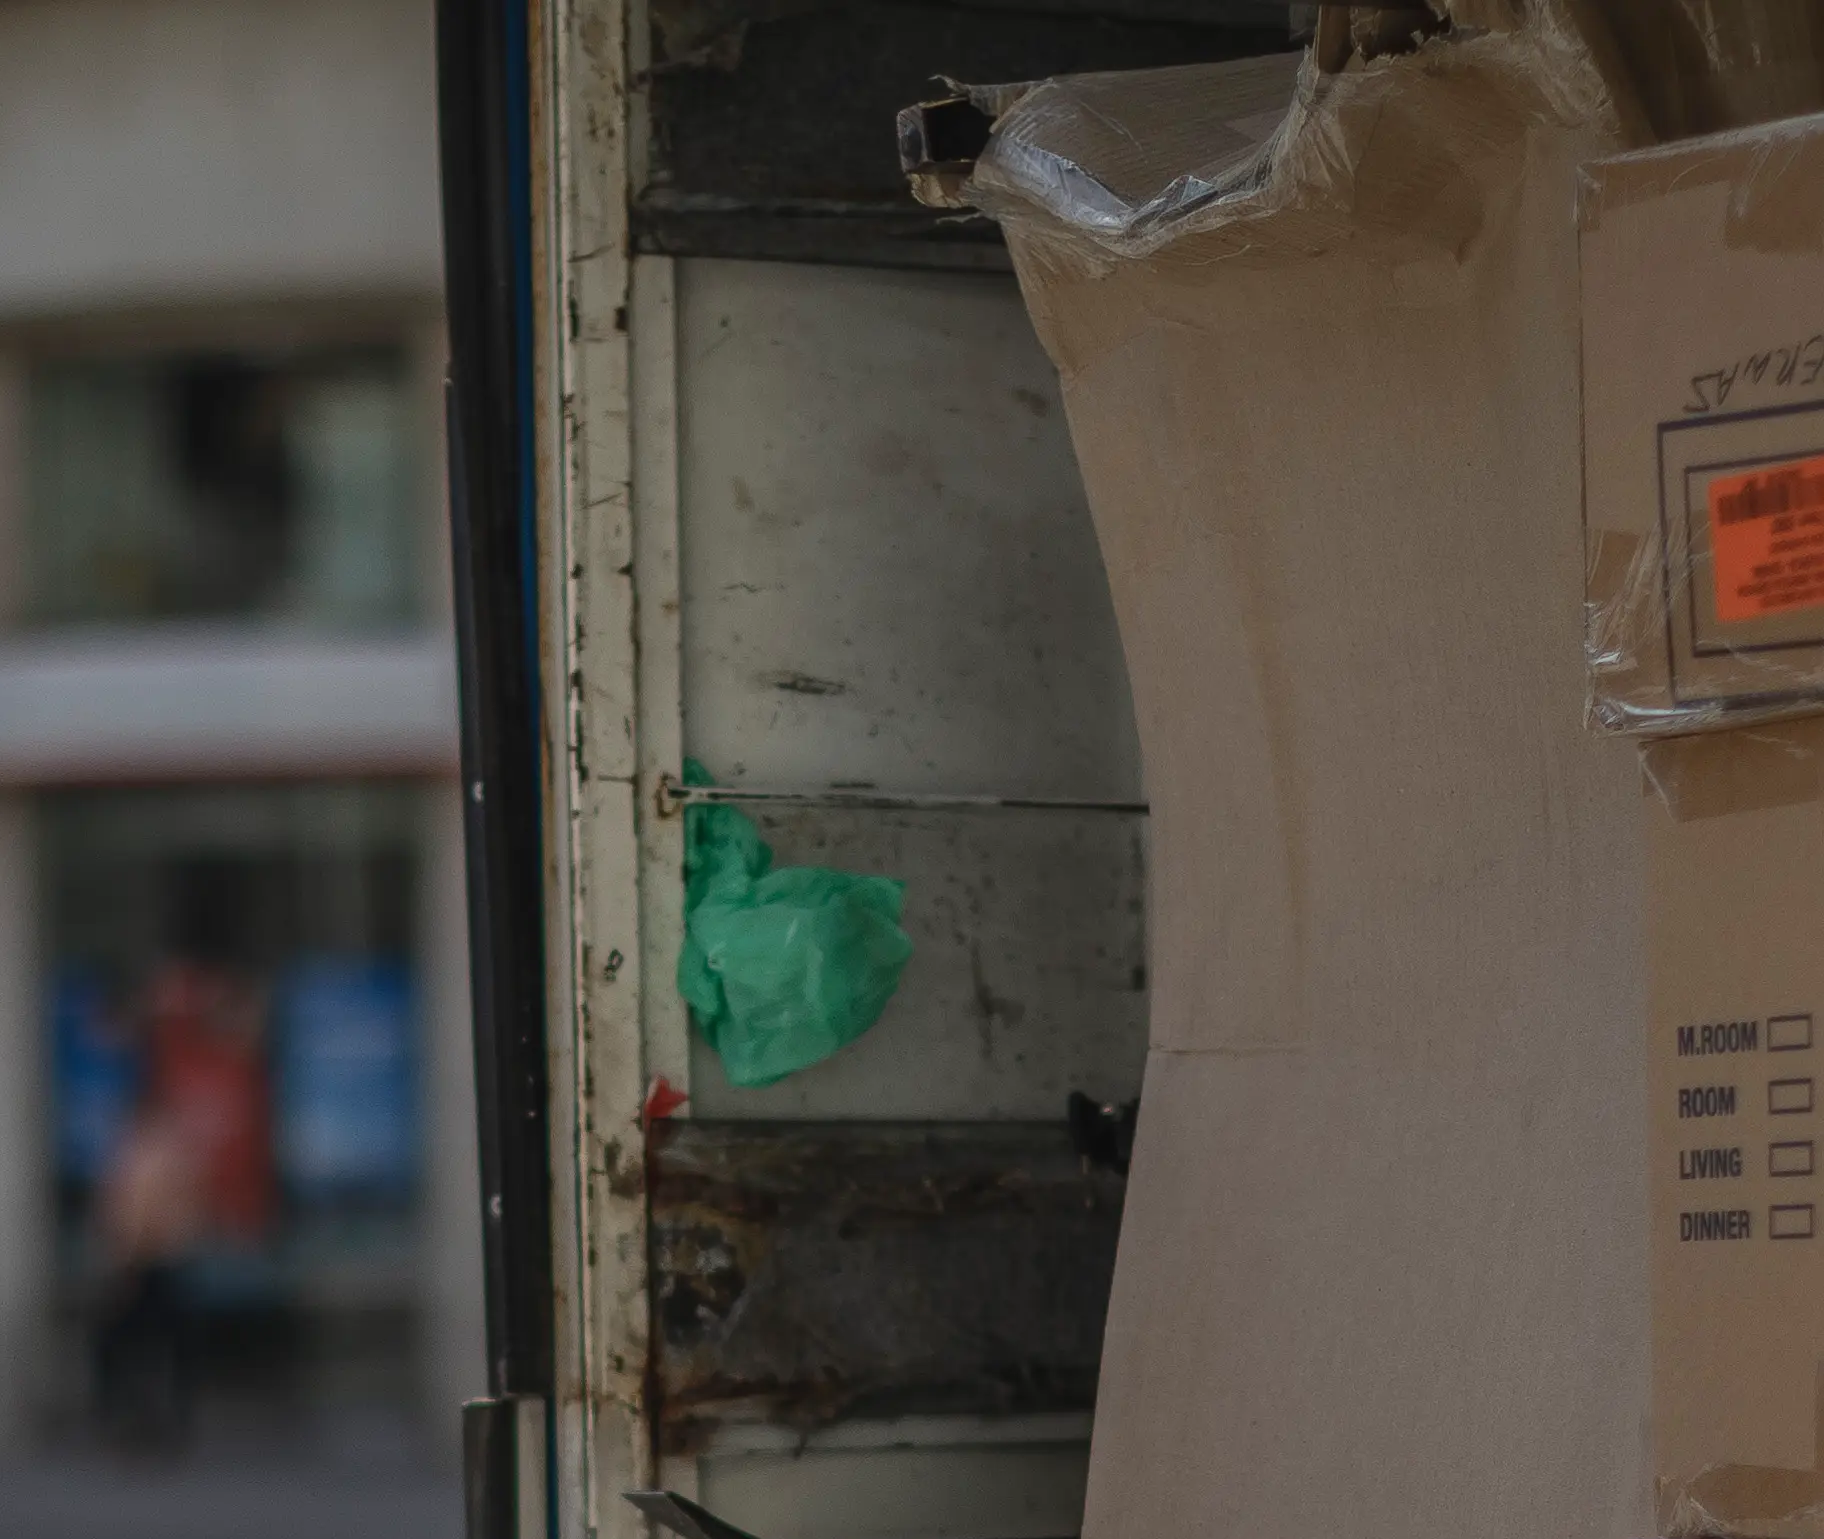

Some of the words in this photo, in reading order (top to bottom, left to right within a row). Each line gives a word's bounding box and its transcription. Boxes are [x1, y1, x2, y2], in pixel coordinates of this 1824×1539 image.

[1677, 1021, 1759, 1057] M.ROOM
[1678, 1086, 1737, 1119] ROOM
[1679, 1147, 1743, 1180] LIVING
[1680, 1209, 1751, 1242] DINNER
